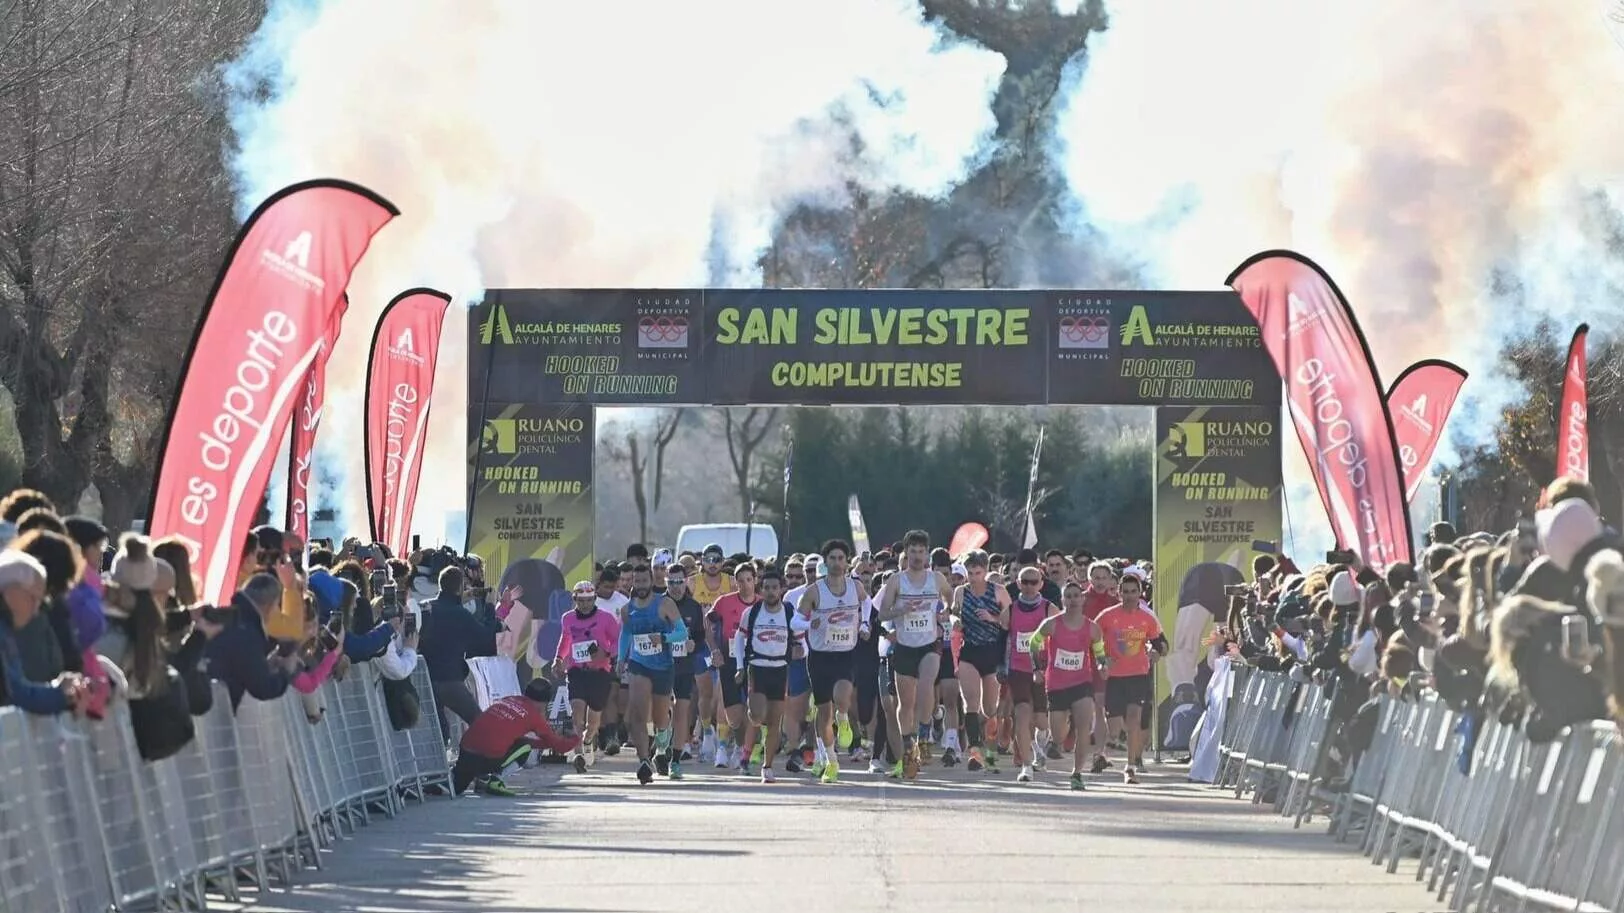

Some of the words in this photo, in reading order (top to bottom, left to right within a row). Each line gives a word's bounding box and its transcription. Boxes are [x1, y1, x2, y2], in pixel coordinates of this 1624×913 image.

[638, 298, 690, 306] CIUDAD
[1058, 298, 1112, 306] CIUDAD
[515, 321, 554, 334] ALCALÁ
[556, 323, 571, 334] DE
[573, 323, 621, 334] HENARES
[716, 307, 798, 344] SAN
[813, 306, 1031, 345] SILVESTRE
[1155, 322, 1195, 336] ALCALÁ
[1196, 325, 1211, 336] DE
[515, 335, 622, 346] AYUNTAMIENTO
[1155, 336, 1262, 348] AYUNTAMIENTO
[637, 352, 688, 360] MUNICIPAL
[1058, 353, 1110, 361] MUNICIPAL
[544, 355, 620, 375] HOOKED
[1121, 358, 1196, 378] HOOKED
[771, 361, 963, 388] COMPLUTENSE
[199, 310, 298, 472] deporte
[563, 375, 589, 395] ON
[593, 375, 678, 395] RUNNING
[1138, 378, 1165, 399] ON
[1169, 379, 1255, 400] RUNNING
[518, 418, 584, 433] RUANO
[1207, 421, 1273, 436] RUANO
[519, 433, 581, 444] POLICLÍNICA
[1207, 436, 1270, 447] POLICLÍNICA
[519, 445, 557, 454] DENTAL
[1207, 447, 1246, 457] DENTAL
[485, 466, 538, 480] HOOKED
[1171, 472, 1226, 487] HOOKED
[499, 481, 517, 494] ON
[520, 481, 582, 494] RUNNING
[1185, 487, 1204, 500] ON
[1207, 487, 1269, 500] RUNNING
[180, 476, 219, 526] es
[516, 503, 543, 515] SAN
[1204, 506, 1233, 519] SAN
[493, 517, 565, 530] SILVESTRE
[1183, 520, 1255, 533] SILVESTRE
[497, 531, 561, 541] COMPLUTENSE
[1187, 534, 1251, 543] COMPLUTENSE
[910, 619, 928, 628] 1157
